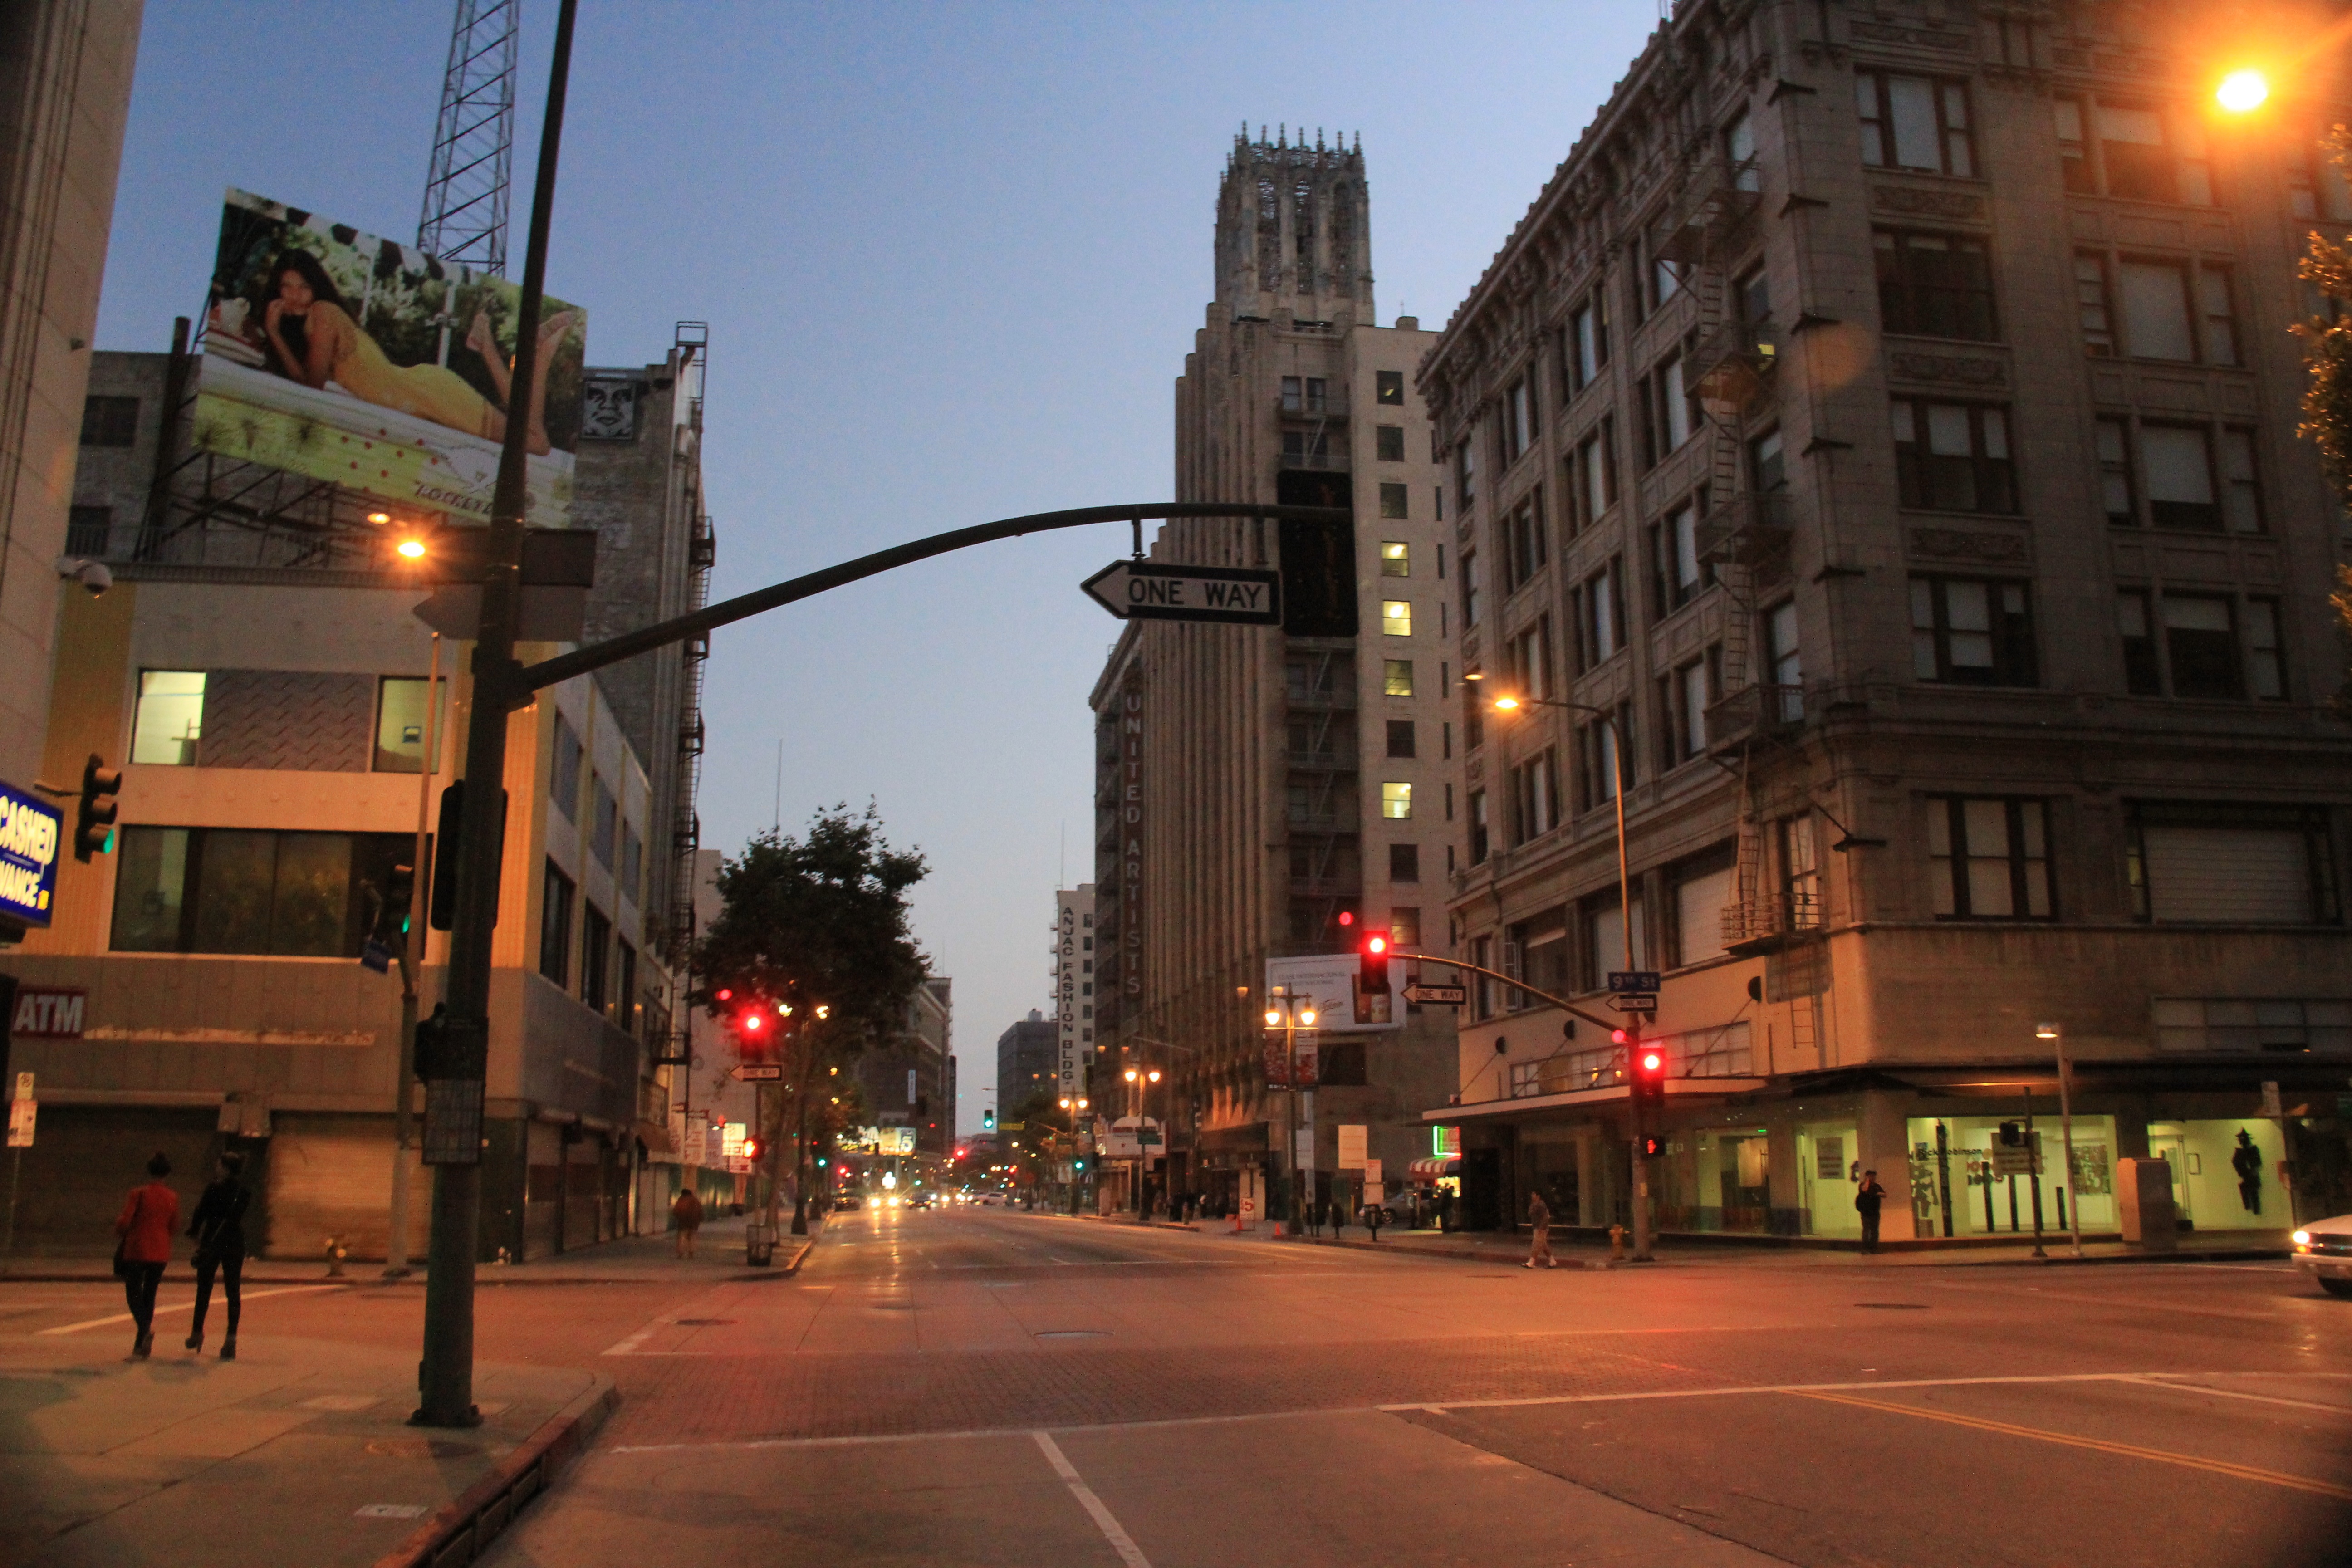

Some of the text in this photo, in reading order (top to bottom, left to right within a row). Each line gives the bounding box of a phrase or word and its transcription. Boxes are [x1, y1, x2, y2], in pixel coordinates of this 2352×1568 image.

[1129, 578, 1262, 609] ONE WAY
[0, 795, 58, 866] CASHED
[1126, 696, 1141, 995] UNITED ARTISTS
[0, 860, 41, 908] VANCE
[1063, 907, 1074, 956] ANJAC
[12, 993, 84, 1033] ATM
[1062, 962, 1073, 1032] FASHION
[1416, 990, 1462, 1000] ONE WAY
[1946, 1147, 1982, 1156] obinson
